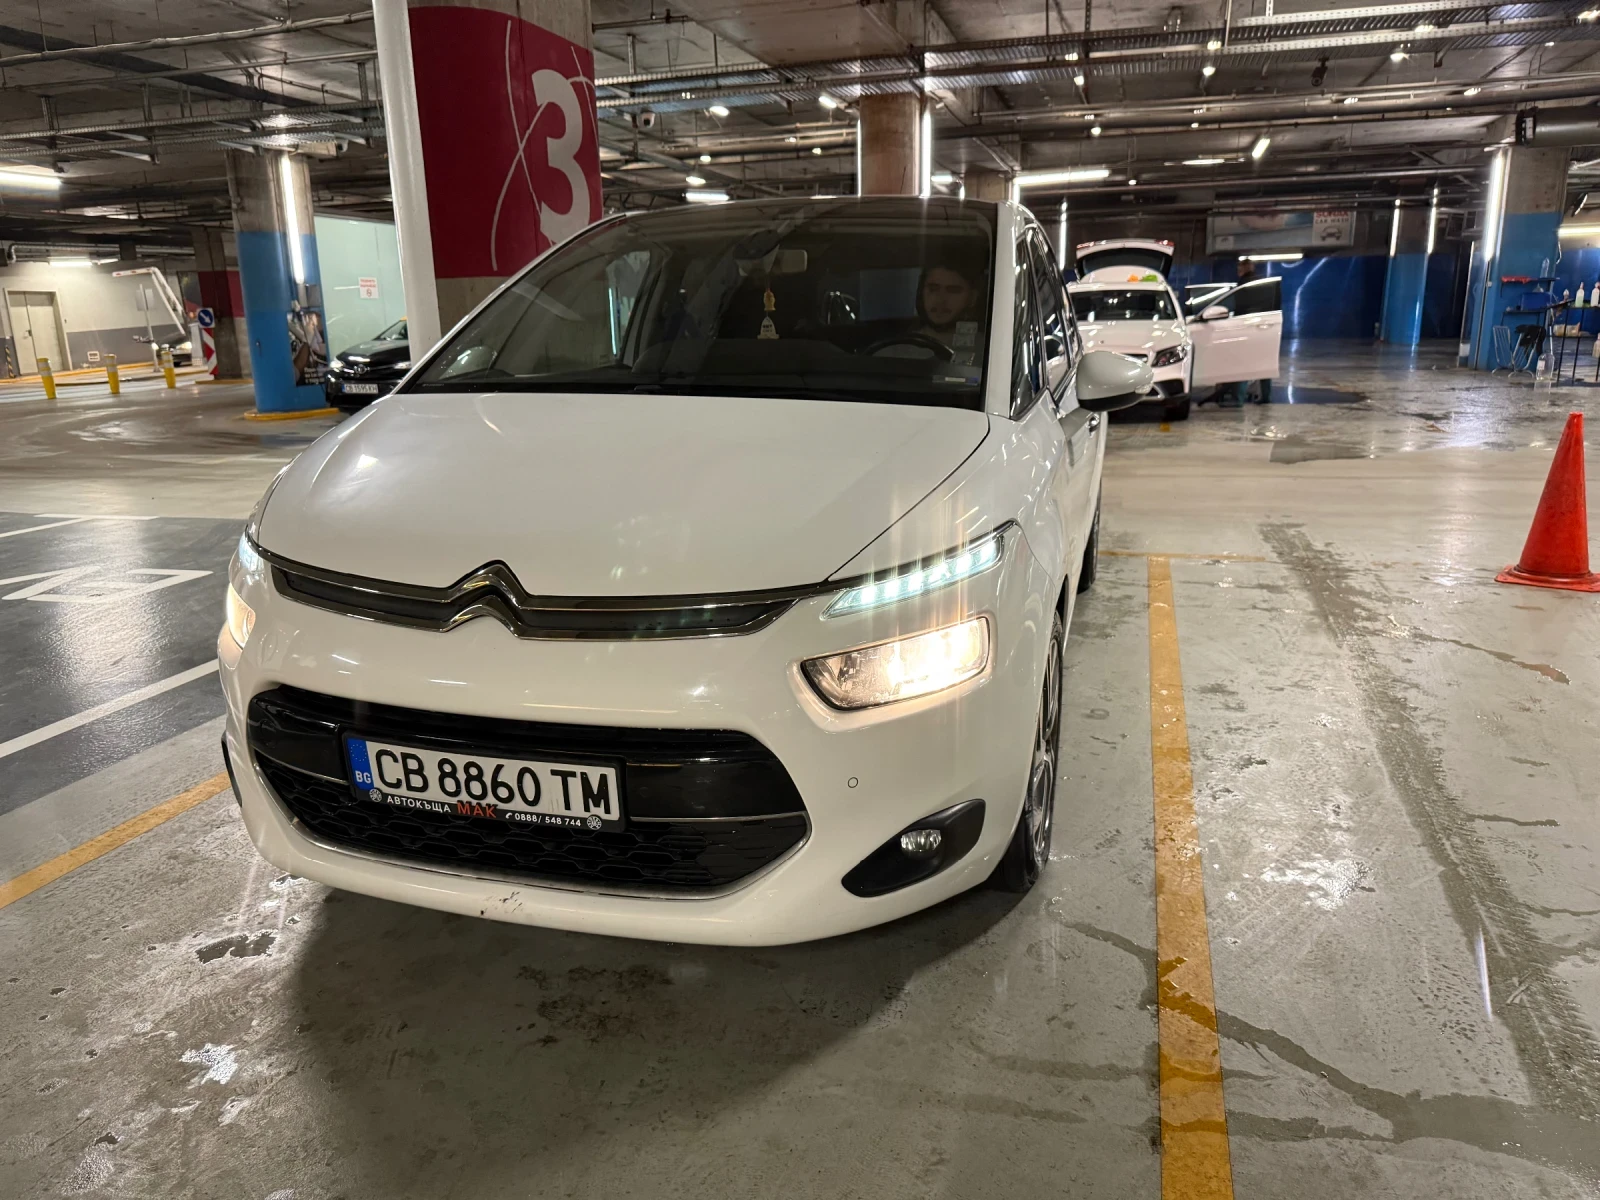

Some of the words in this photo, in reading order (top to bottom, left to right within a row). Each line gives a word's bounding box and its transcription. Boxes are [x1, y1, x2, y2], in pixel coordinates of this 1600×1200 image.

[531, 69, 590, 245] 3
[355, 770, 372, 784] BG
[437, 757, 542, 807] 8860
[387, 795, 452, 813] АВТОКЪЩА
[514, 812, 542, 824] 0888/
[545, 816, 562, 825] 548
[564, 818, 582, 827] 744
